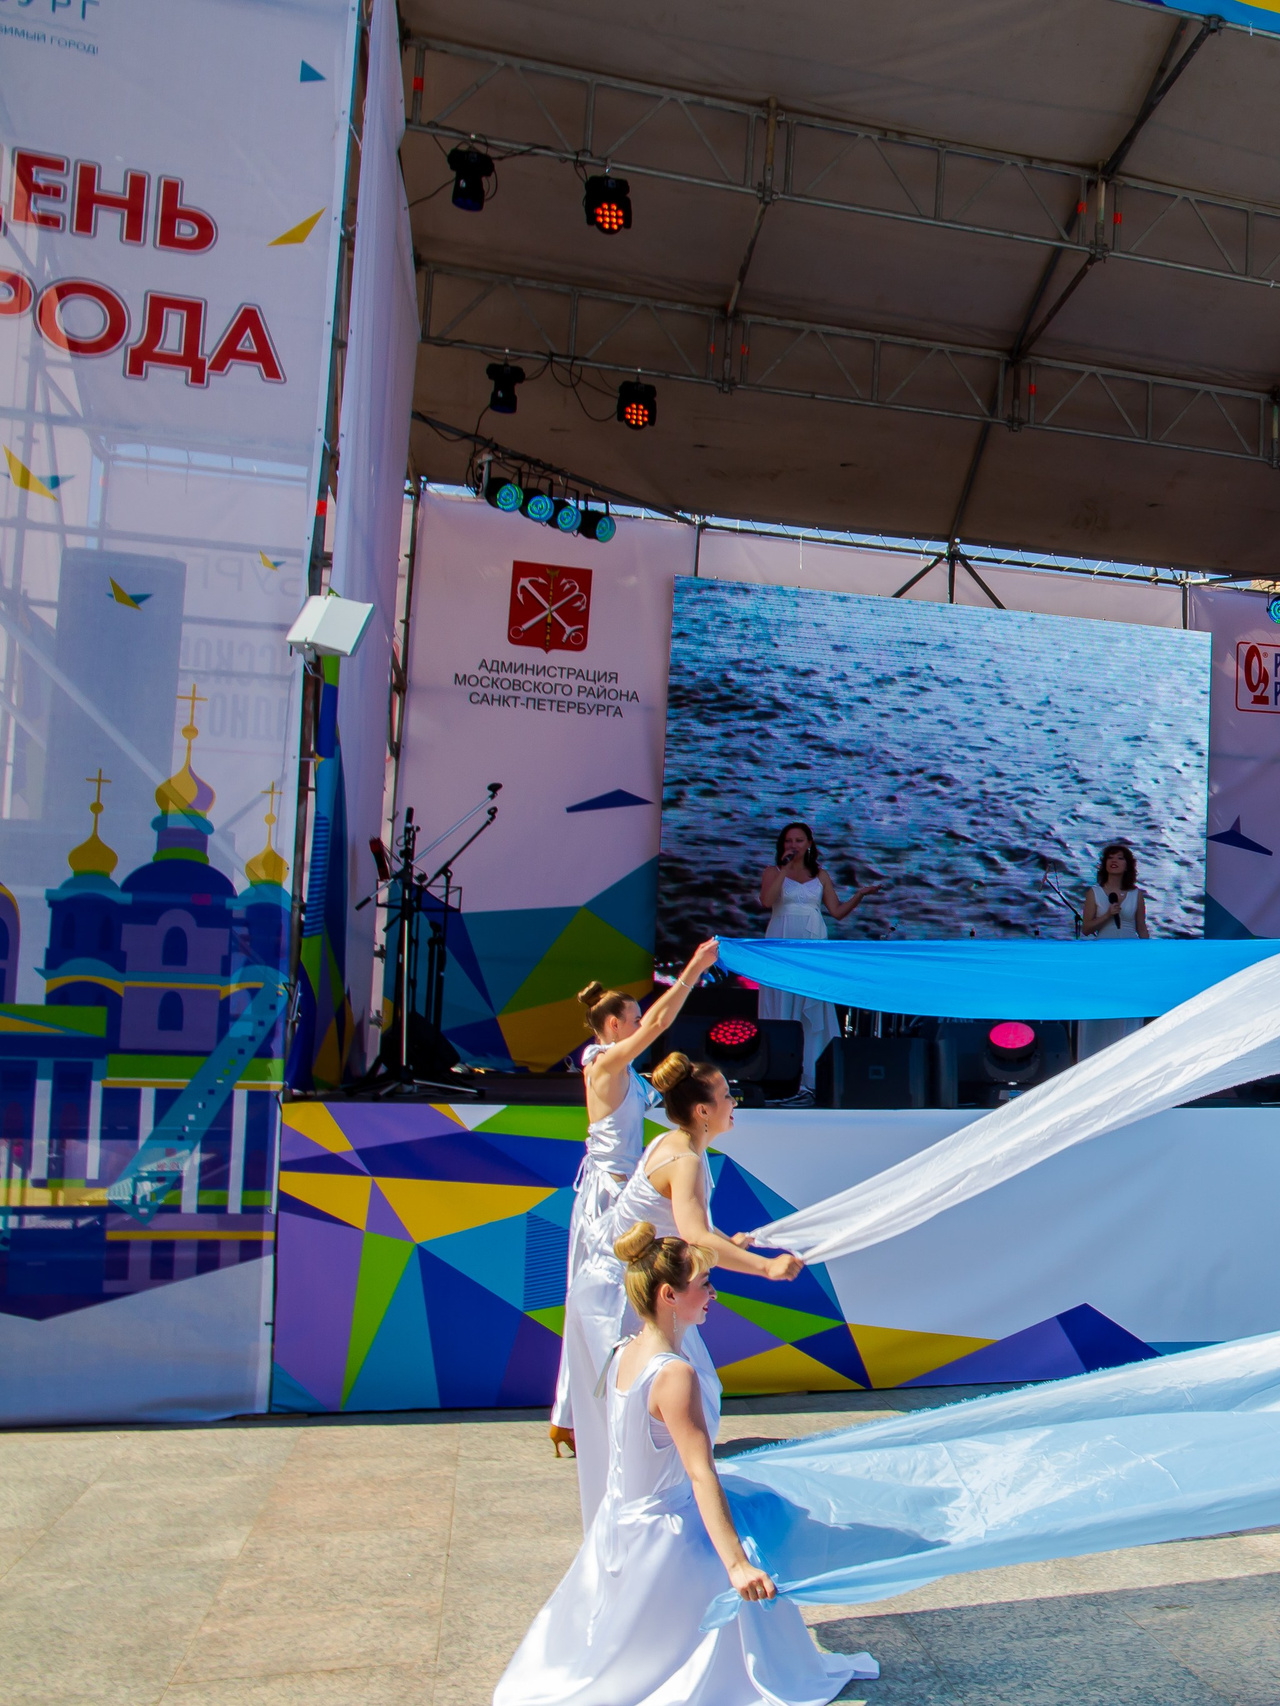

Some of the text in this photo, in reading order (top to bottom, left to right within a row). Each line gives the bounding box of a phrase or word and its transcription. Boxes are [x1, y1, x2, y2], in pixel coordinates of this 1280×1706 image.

[0, 146, 218, 255] ЕНЬ
[478, 658, 618, 684] АДМИНИСТРАЦИЯ
[453, 673, 640, 703] МОСКОВСКОГО РАЙОНА
[469, 691, 623, 718] САНКТ-ПЕТЕРБУРГА
